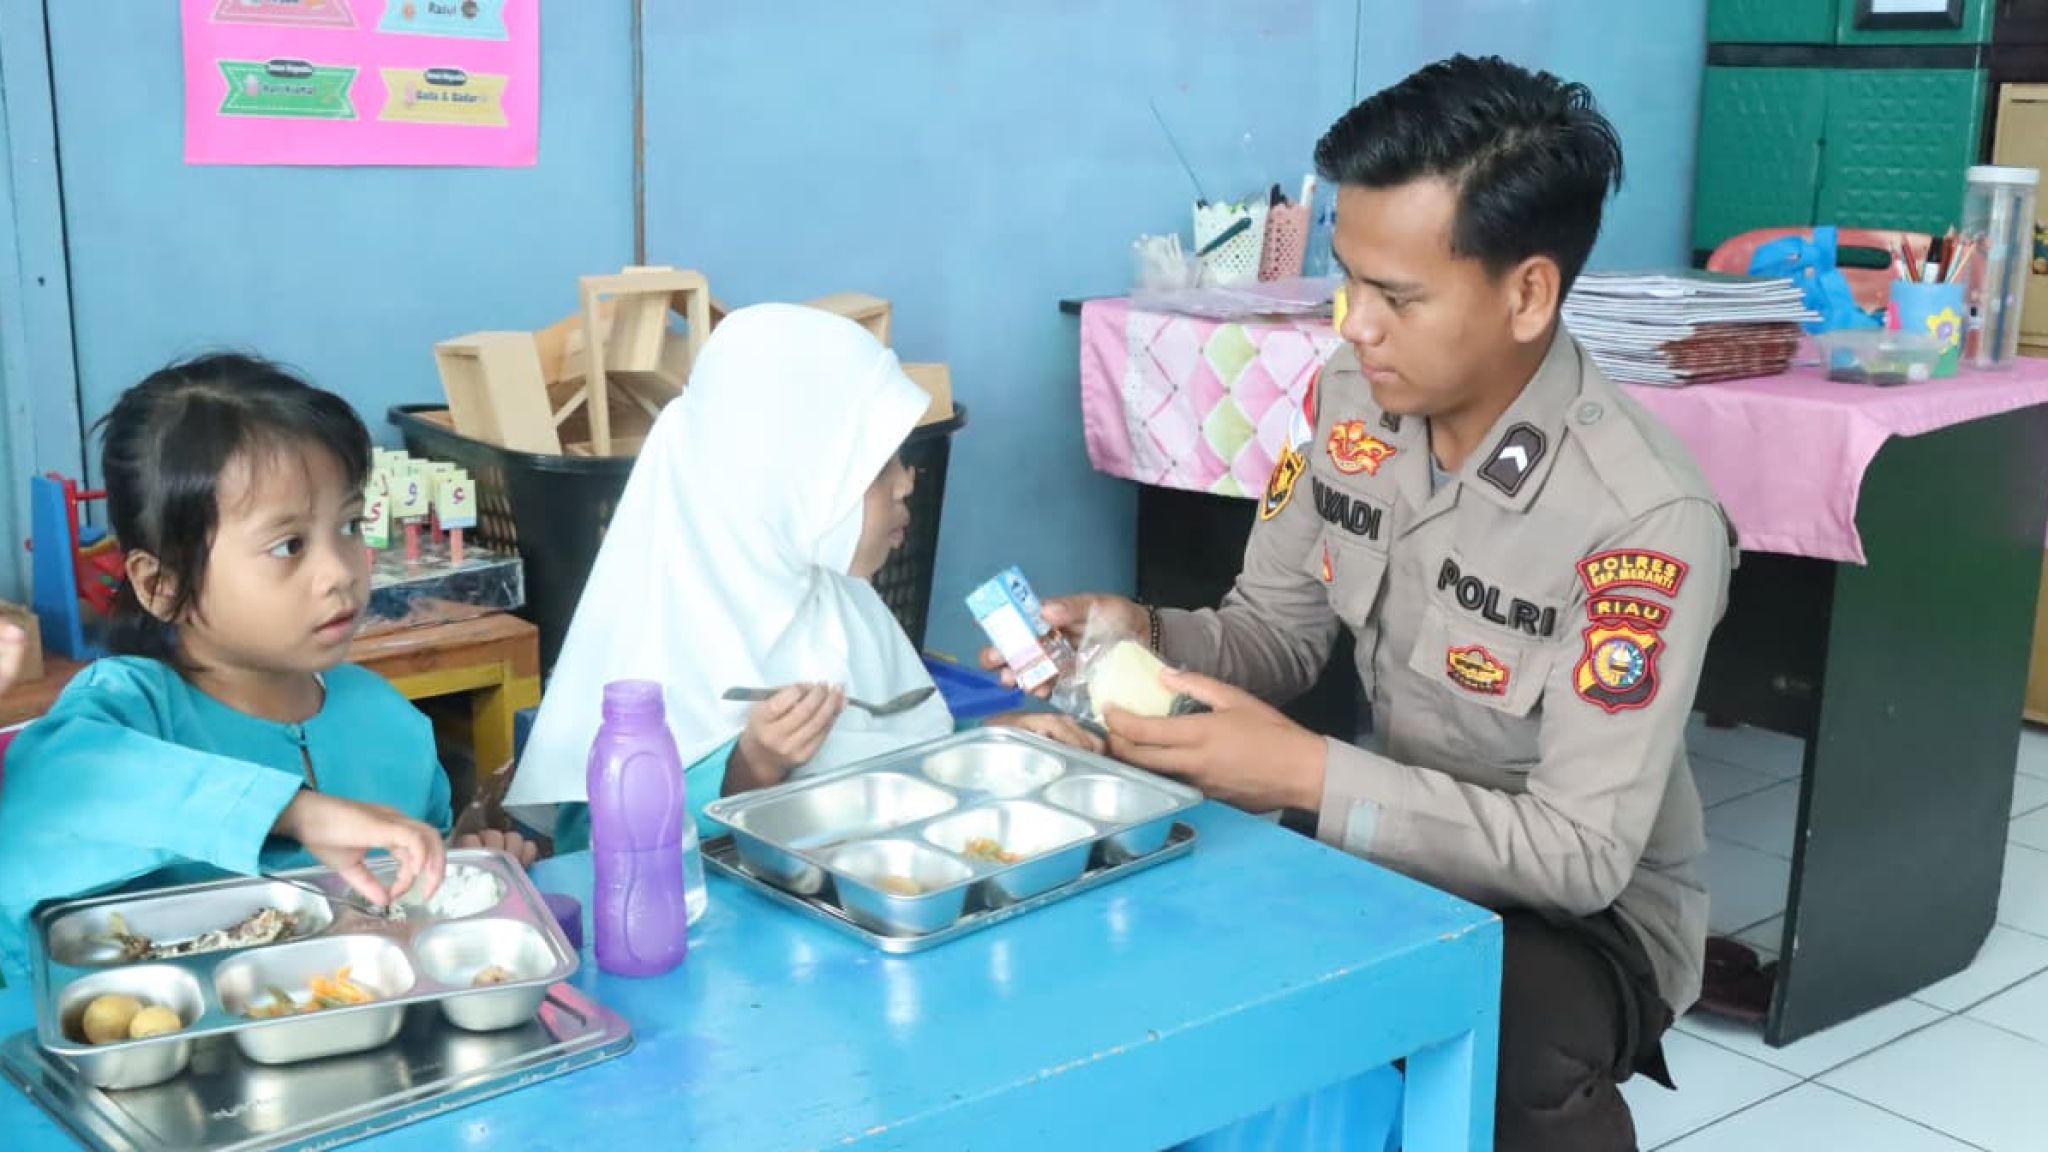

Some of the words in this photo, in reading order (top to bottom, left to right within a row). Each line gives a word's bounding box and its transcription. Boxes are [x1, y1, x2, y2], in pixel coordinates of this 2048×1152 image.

[427, 1, 457, 16] Rasul
[1587, 554, 1677, 577] POLRES
[1437, 557, 1557, 638] POLRI
[1597, 600, 1661, 620] RIAU
